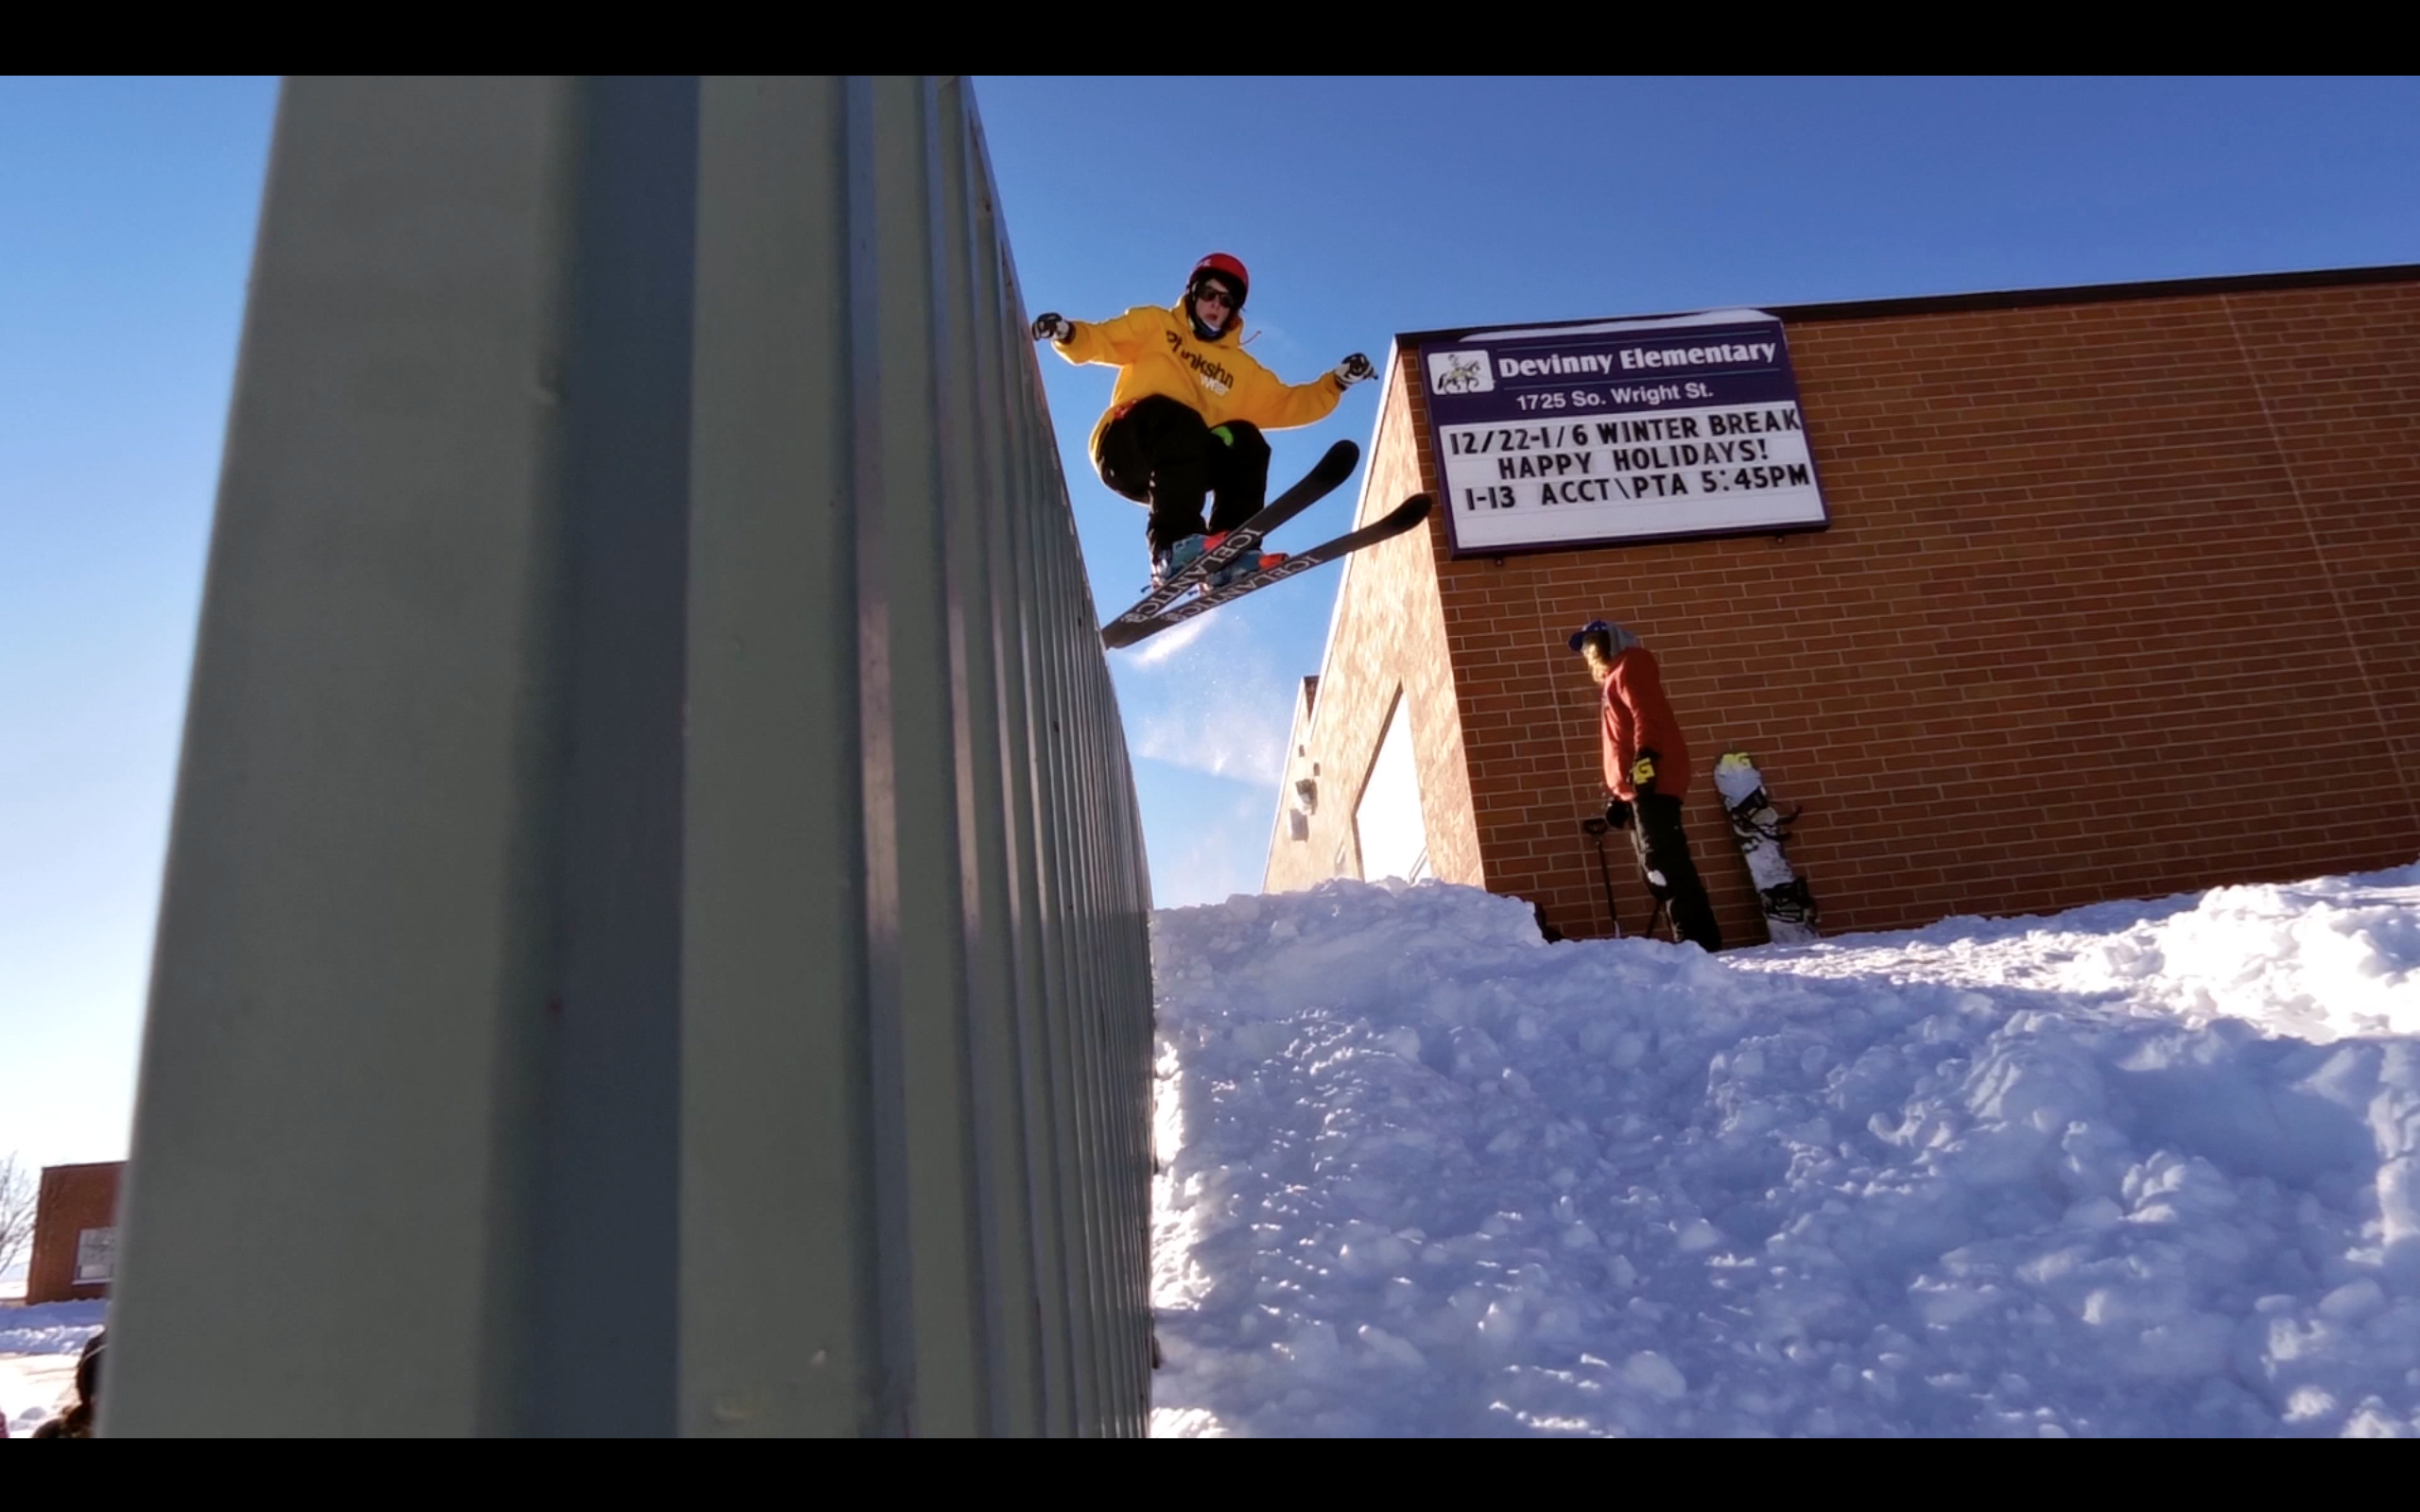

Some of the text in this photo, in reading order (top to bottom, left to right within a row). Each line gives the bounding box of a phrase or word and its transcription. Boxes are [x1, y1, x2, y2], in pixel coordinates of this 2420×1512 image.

[1498, 343, 1776, 377] Devinny Elementary
[1516, 382, 1714, 410] 1725 So. Wright St.
[1449, 408, 1802, 455] 12/22-1/6 WINTER BREAK
[1497, 438, 1769, 479] HAPPY HOLIDAYS!
[1465, 463, 1810, 510] 1-13 ACCT\PTA 5:45PM
[1136, 527, 1264, 617] ICELANTIC
[1184, 555, 1322, 618] ICELANTIC
